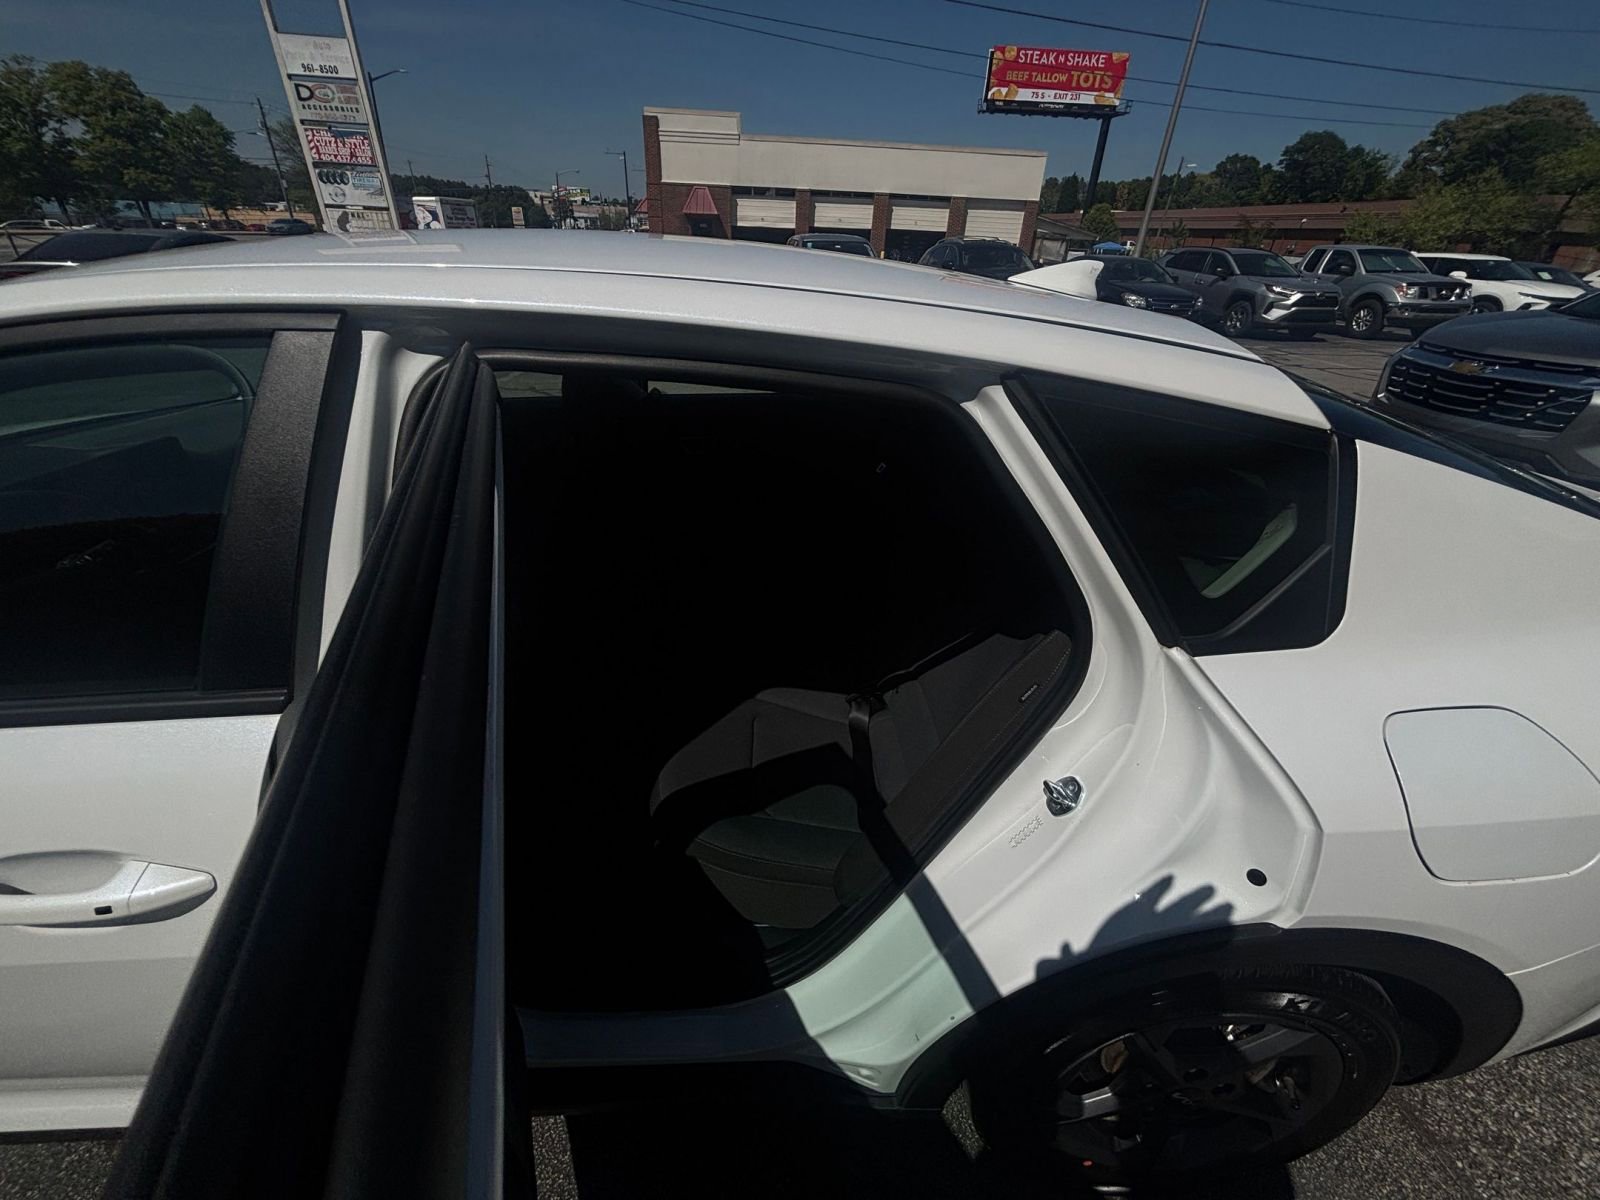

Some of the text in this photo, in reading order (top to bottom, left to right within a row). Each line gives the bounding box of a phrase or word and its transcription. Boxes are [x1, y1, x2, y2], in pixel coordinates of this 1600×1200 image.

[1018, 50, 1106, 68] STEAK N SHAKE
[301, 63, 339, 74] 961-8500
[1006, 70, 1113, 89] BEEF TALLOW TOTS
[1031, 91, 1039, 99] 75
[1069, 93, 1081, 101] 231
[302, 103, 360, 113] ACCESSORIES
[314, 136, 337, 148] CUTZ
[344, 139, 370, 149] STYLE
